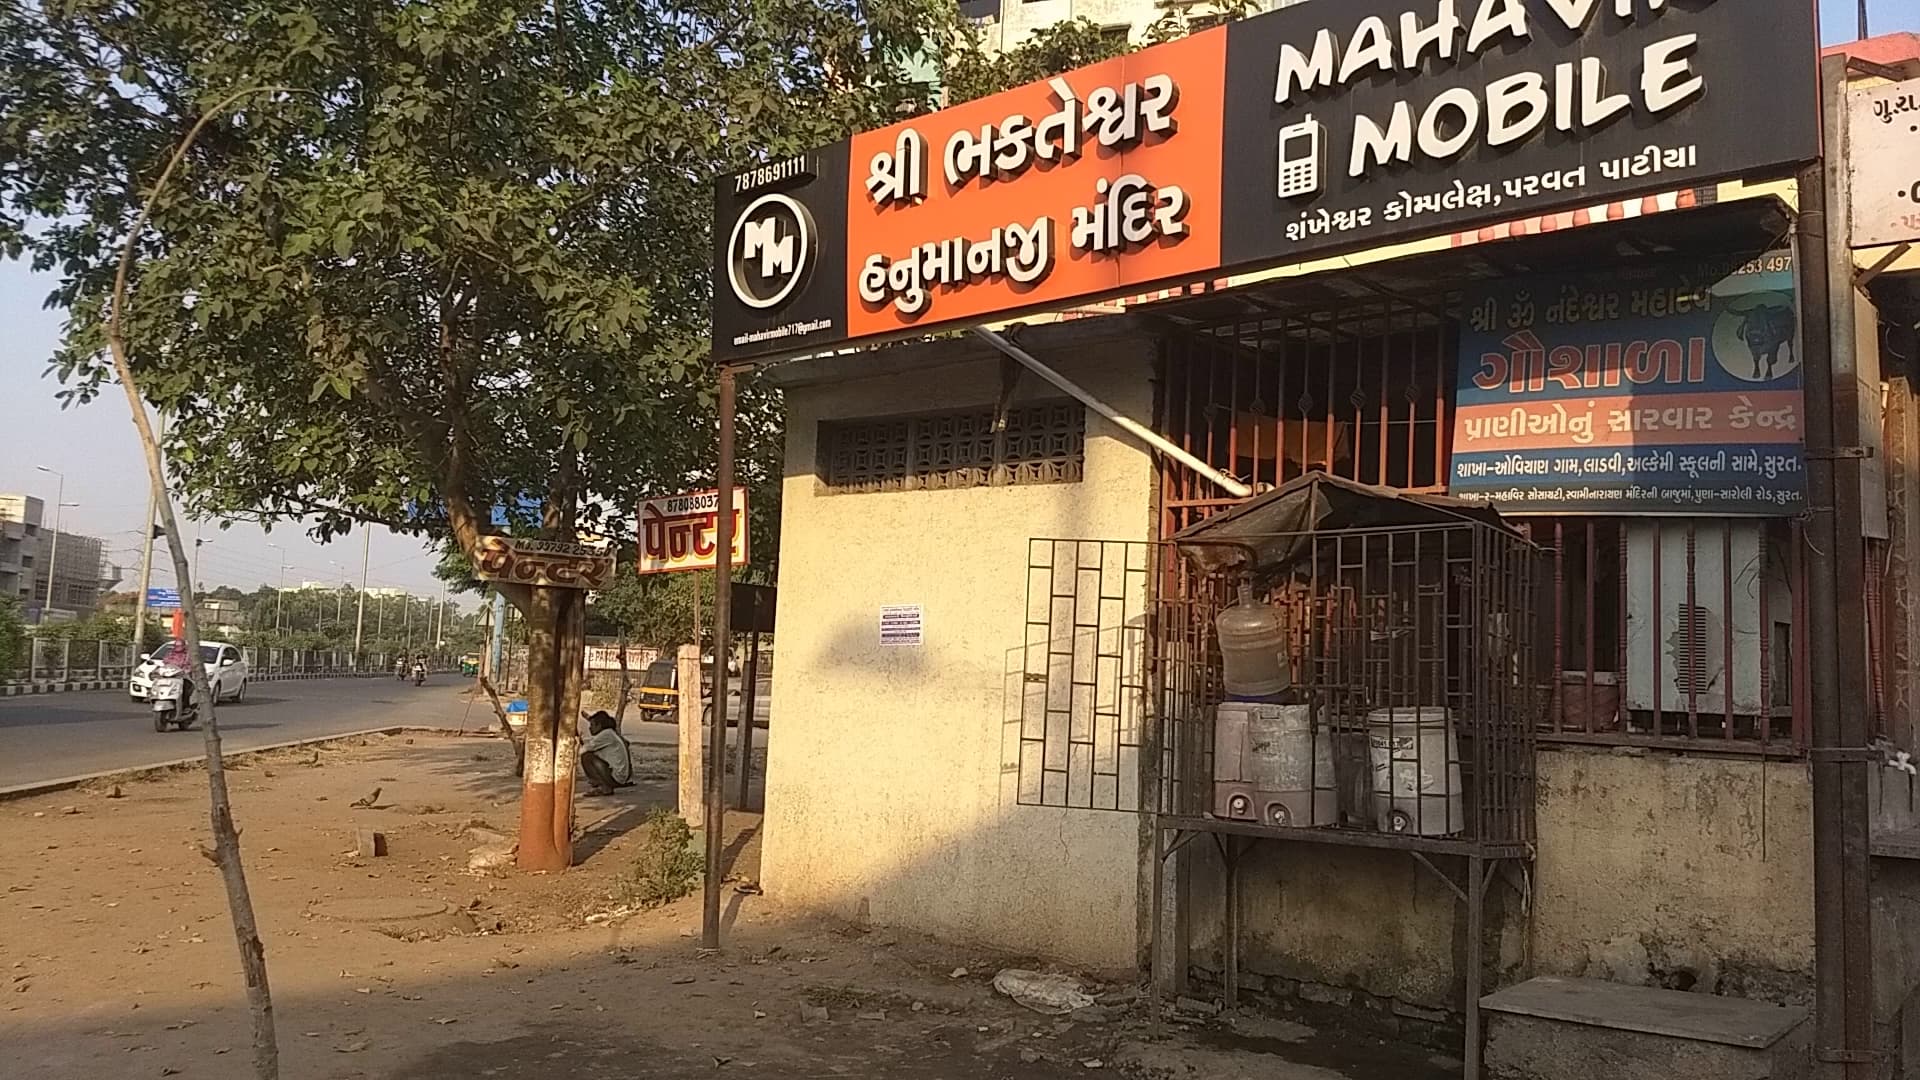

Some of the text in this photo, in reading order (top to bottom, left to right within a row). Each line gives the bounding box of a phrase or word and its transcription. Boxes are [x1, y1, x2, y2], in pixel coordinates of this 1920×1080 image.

[1274, 0, 1663, 103] MAHAV
[1349, 33, 1703, 177] MOBILE
[734, 154, 806, 193] 7878691111
[865, 128, 923, 203] શ્રી
[1285, 206, 1372, 241] શંખેશ્વર
[1600, 144, 1696, 180] પાટીયા
[858, 173, 1187, 313] હનુમાનજી મંદિર
[1470, 297, 1498, 334] શ્રી
[1631, 276, 1713, 318] મહાદેવ
[1464, 396, 1797, 443] પ્રાણીઓનું સારવાર કેન્દ્ર
[667, 494, 719, 513] 878088037
